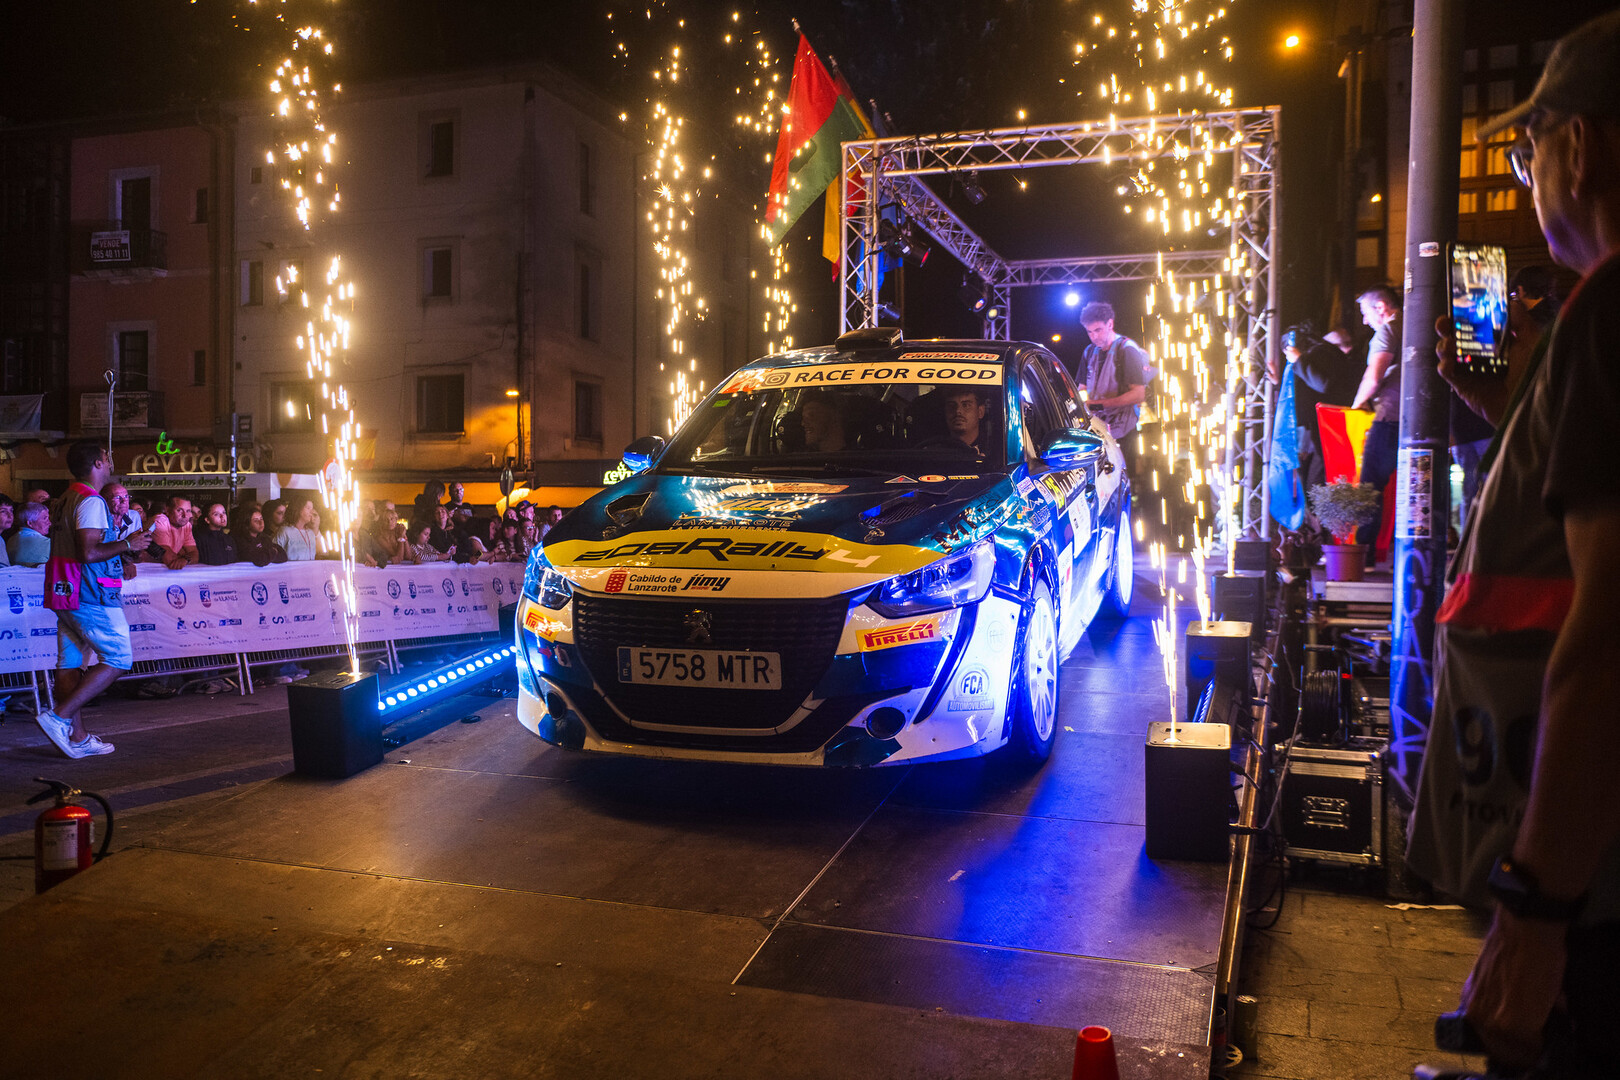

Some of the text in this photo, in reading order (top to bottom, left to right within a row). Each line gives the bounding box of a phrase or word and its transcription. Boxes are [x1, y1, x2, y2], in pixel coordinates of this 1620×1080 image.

[795, 371, 853, 383] RACE
[860, 369, 909, 381] FOR
[917, 368, 997, 380] GOOD
[629, 574, 682, 584] Cabildo de
[54, 584, 72, 594] FIA
[628, 583, 678, 592] Lanzarote
[864, 623, 934, 648] PIRELLI
[639, 652, 706, 681] 5758
[717, 655, 770, 684] MTR
[963, 675, 983, 694] FCA
